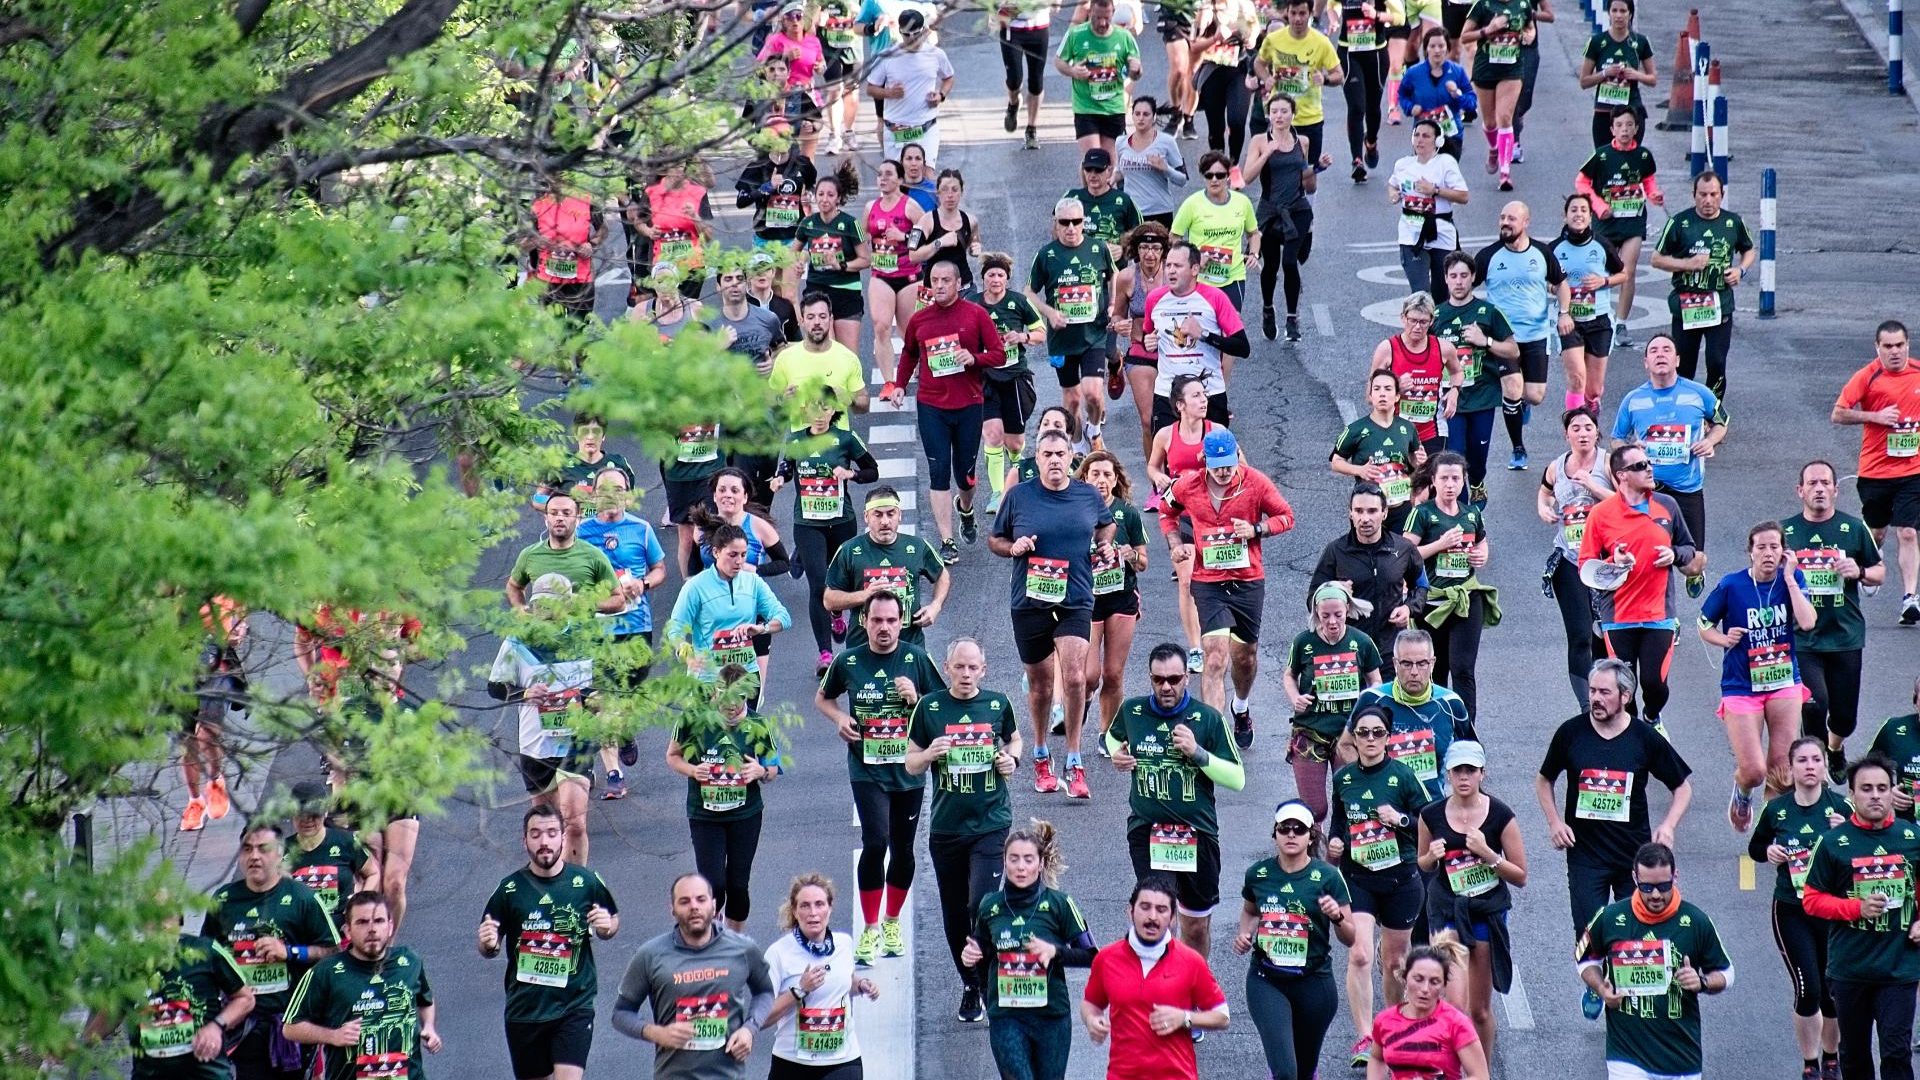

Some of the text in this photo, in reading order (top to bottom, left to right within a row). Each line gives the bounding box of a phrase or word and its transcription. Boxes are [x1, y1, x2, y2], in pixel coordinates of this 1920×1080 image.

[1658, 447, 1676, 456] 26301
[813, 502, 832, 511] 41915
[1215, 551, 1236, 561] 43163
[1095, 575, 1115, 586] 40901
[1811, 574, 1832, 585] 42954
[1037, 583, 1059, 594] 42936
[1749, 624, 1787, 642] FOR THE
[727, 653, 748, 663] 41770
[1765, 671, 1786, 681] 41624
[1330, 680, 1352, 691] 40676
[856, 692, 884, 700] MADRID
[877, 744, 900, 755] 42804
[1136, 744, 1164, 753] MADRID
[962, 751, 985, 763] 41756
[1592, 797, 1616, 810] 42572
[1165, 850, 1188, 861] 41644
[1366, 847, 1390, 861] 40694
[1466, 870, 1490, 886] 40897
[1260, 906, 1287, 914] MADRID
[521, 922, 551, 931] MADRID
[1273, 942, 1297, 954] 40834
[534, 960, 559, 975] 42859
[252, 969, 277, 983] 42384
[1630, 971, 1656, 984] 42659
[1013, 985, 1037, 996] 41987
[352, 1000, 385, 1012] MADRID
[695, 1026, 717, 1038] 2630
[160, 1031, 185, 1046] 40821
[814, 1036, 838, 1050] 41439
